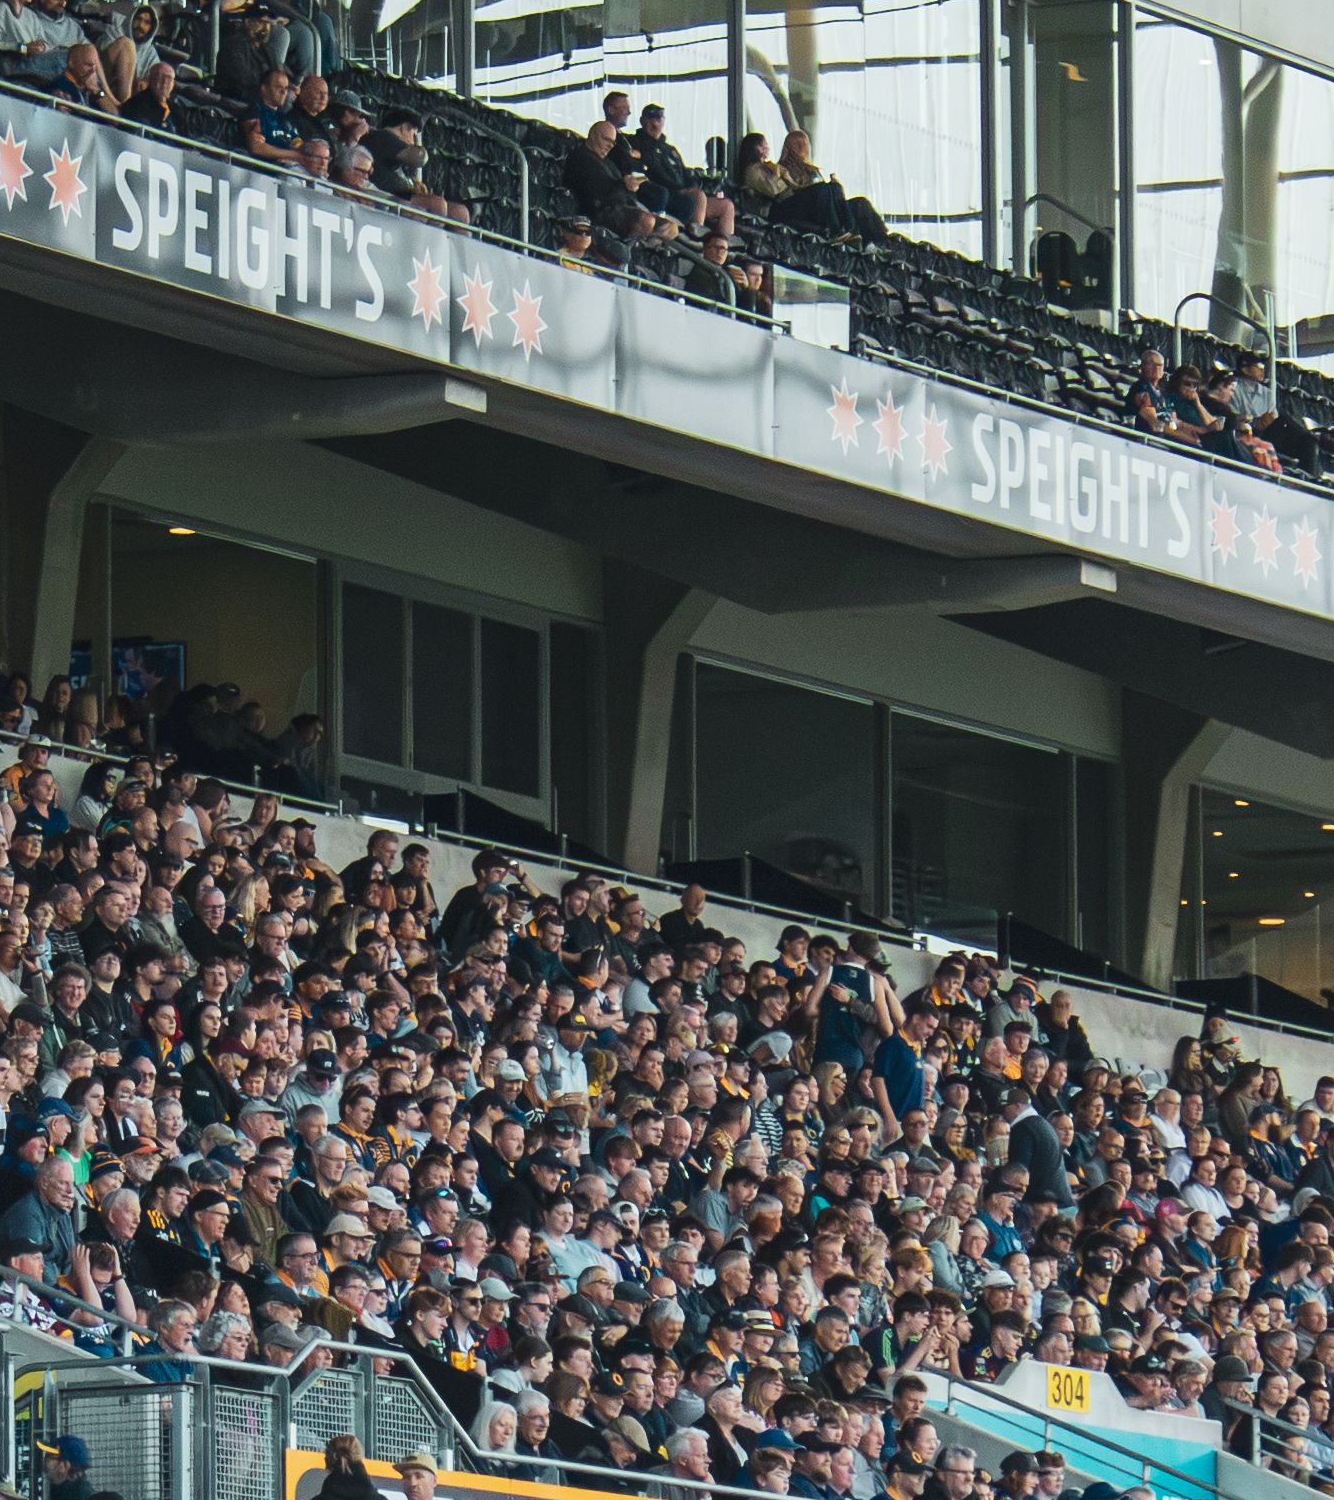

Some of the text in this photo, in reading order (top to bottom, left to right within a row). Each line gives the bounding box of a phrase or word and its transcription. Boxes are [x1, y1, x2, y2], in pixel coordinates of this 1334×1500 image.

[112, 150, 385, 323] SPEIGHT'S
[971, 412, 1192, 559] SPEIGHT'S
[1052, 1372, 1085, 1408] 304
